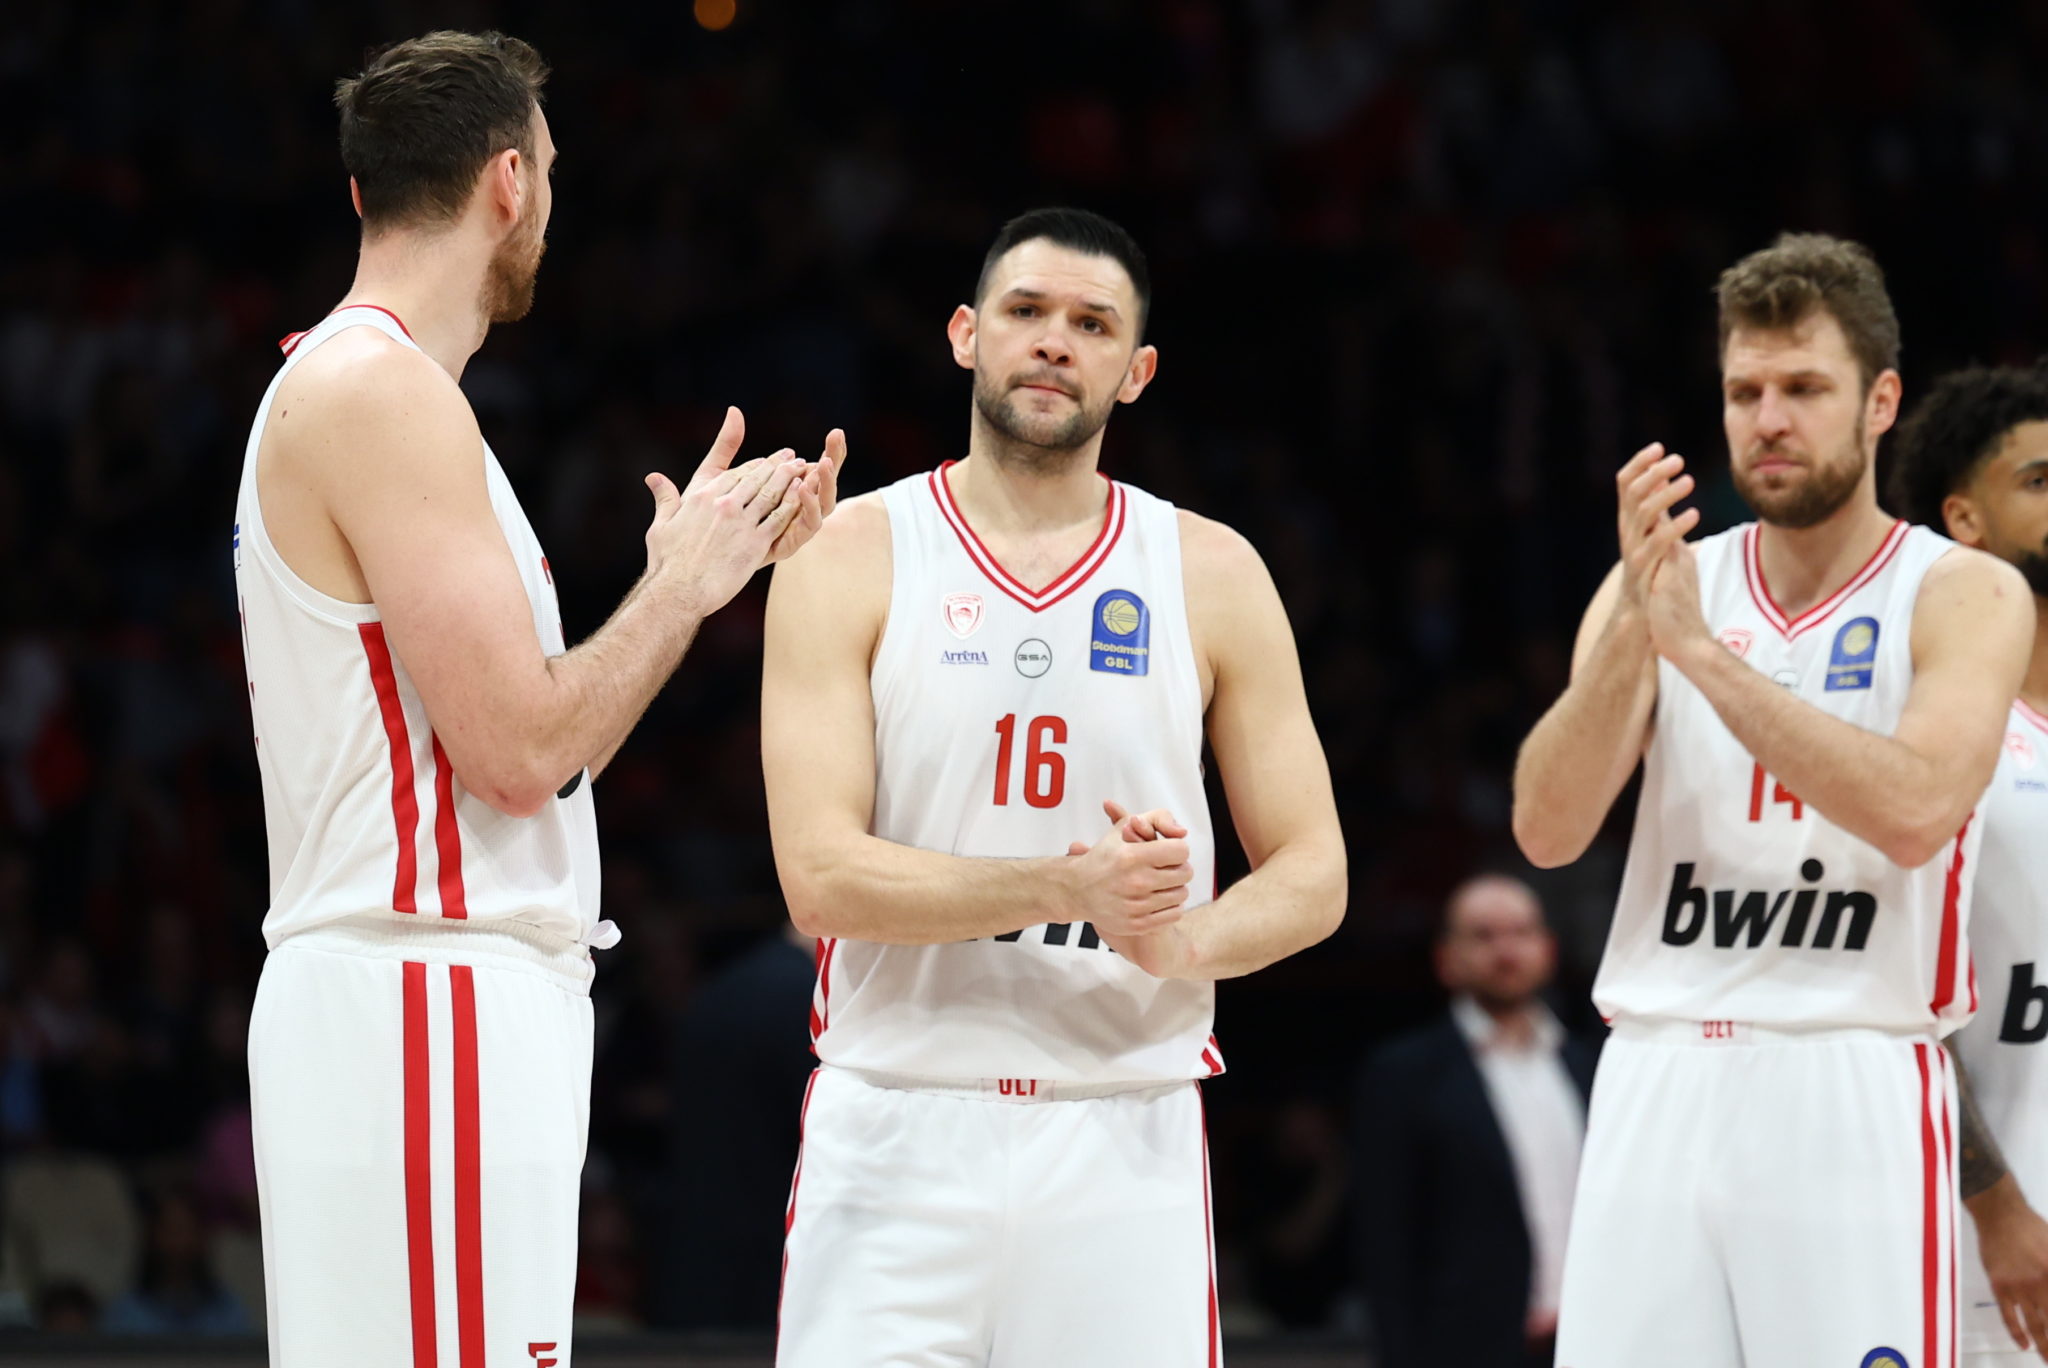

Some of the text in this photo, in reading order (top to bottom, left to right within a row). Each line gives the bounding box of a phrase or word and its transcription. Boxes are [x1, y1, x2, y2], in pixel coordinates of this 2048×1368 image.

[1105, 656, 1133, 670] GBL
[993, 713, 1067, 809] 16
[1661, 858, 1877, 950] bwin
